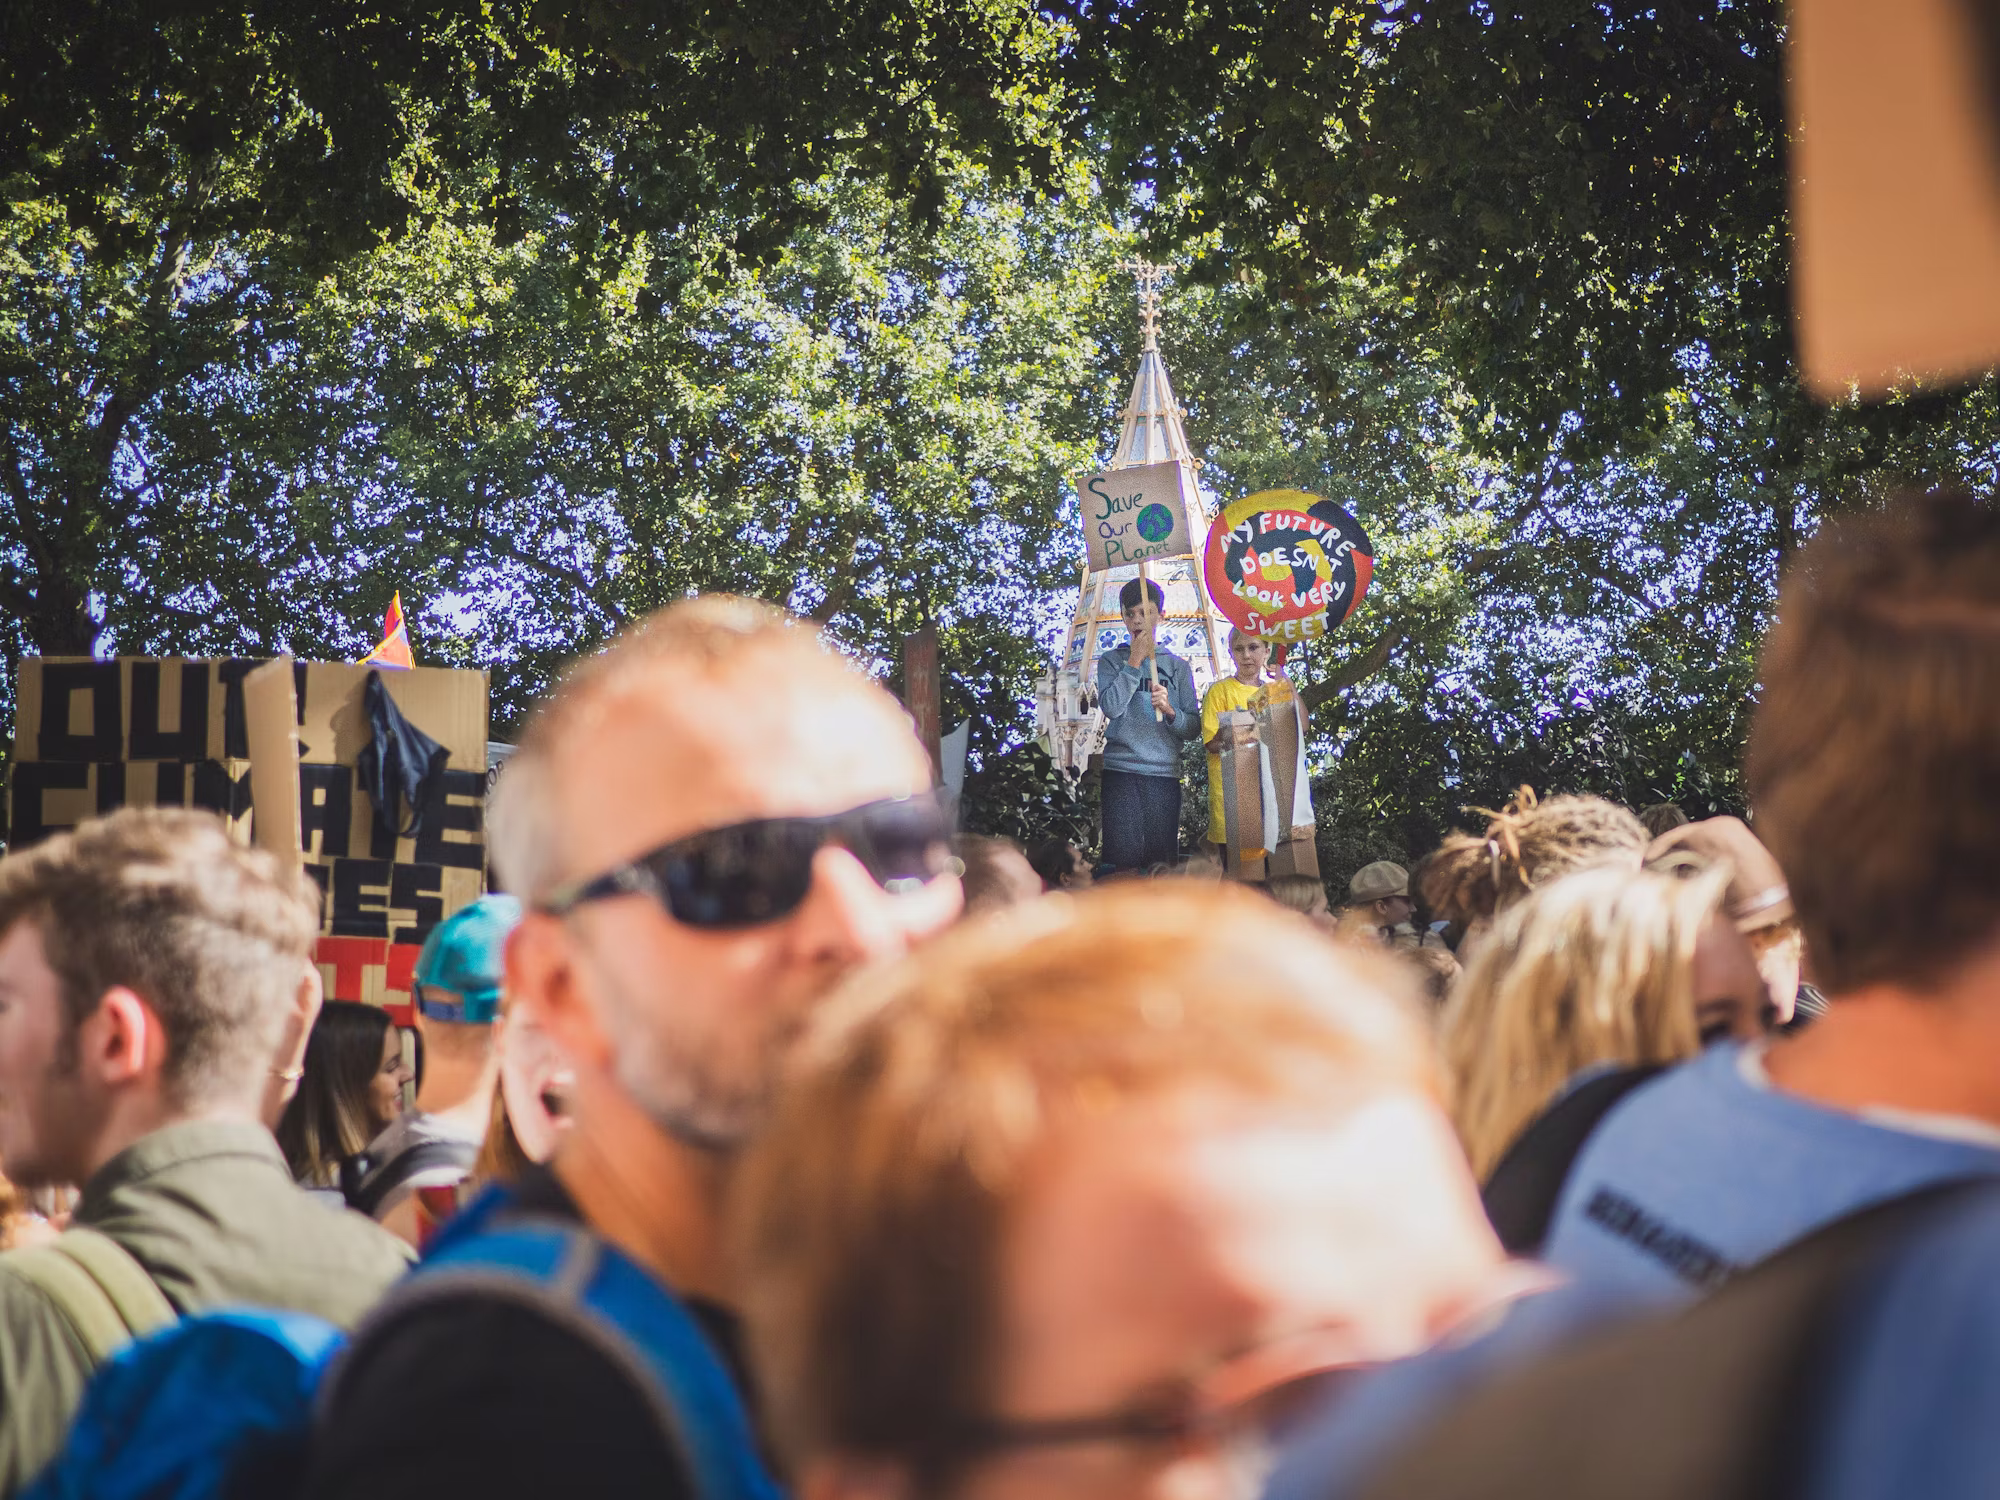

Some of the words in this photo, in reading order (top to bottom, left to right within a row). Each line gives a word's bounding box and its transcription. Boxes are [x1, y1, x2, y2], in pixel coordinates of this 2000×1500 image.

[1088, 478, 1144, 520] Save
[1098, 521, 1132, 539] Our
[1220, 520, 1254, 554] MY
[1259, 512, 1357, 558] FUTURE
[1239, 547, 1342, 574] DOESN'T
[1290, 581, 1346, 608] VERY
[1244, 612, 1330, 638] SWEET
